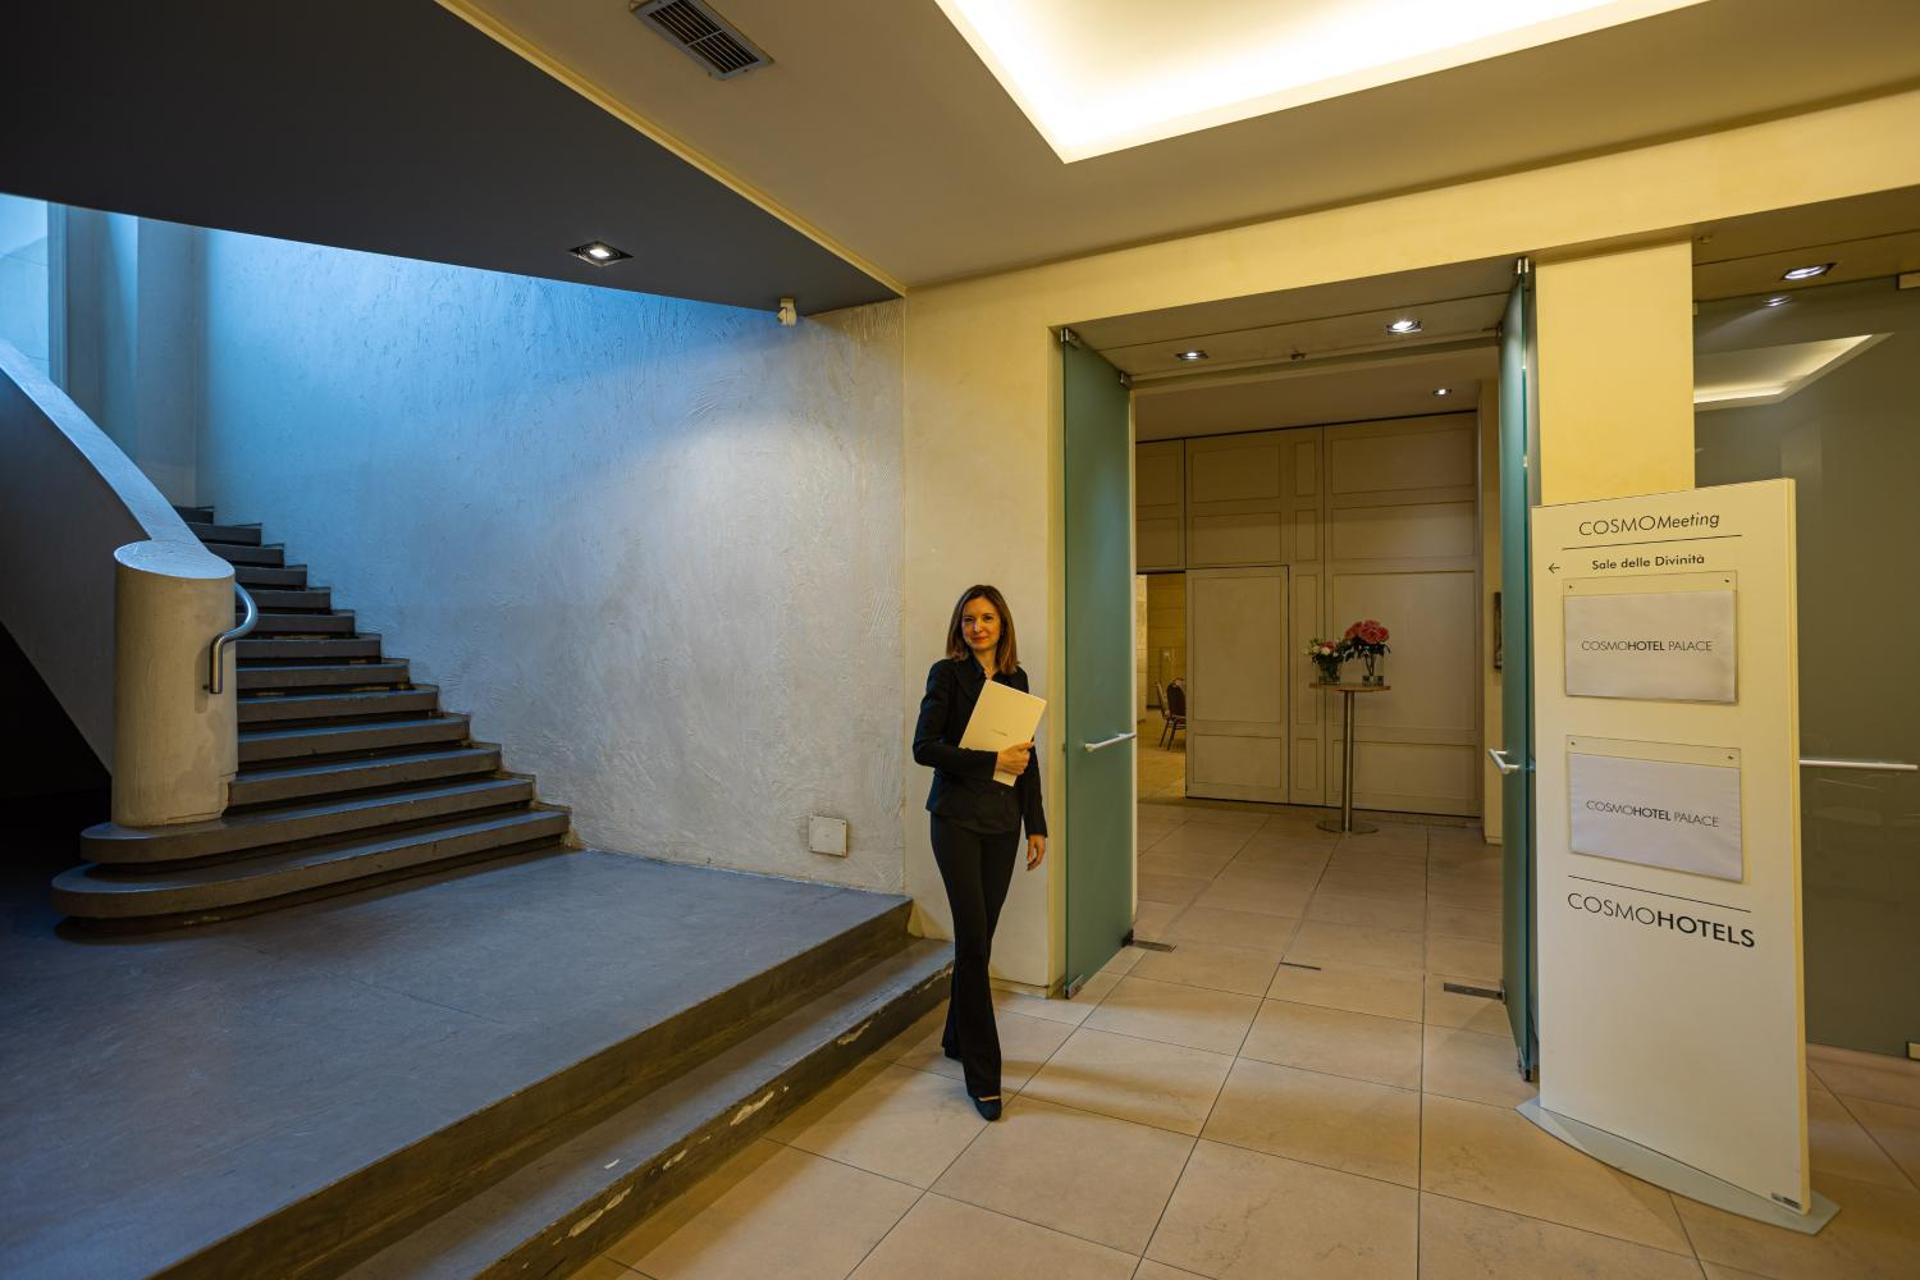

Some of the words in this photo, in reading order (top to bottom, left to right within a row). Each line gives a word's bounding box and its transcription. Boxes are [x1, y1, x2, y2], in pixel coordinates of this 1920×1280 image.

[1579, 512, 1719, 535] COSMOMeeting
[1592, 559, 1617, 570] Sale
[1621, 557, 1650, 569] delle
[1581, 640, 1665, 651] COSMOHOTEL
[1668, 640, 1713, 651] PALACE
[1586, 800, 1671, 821] COSMOHOTEL
[1673, 812, 1720, 828] PALACE
[1567, 892, 1755, 948] COSMOHOTELS
